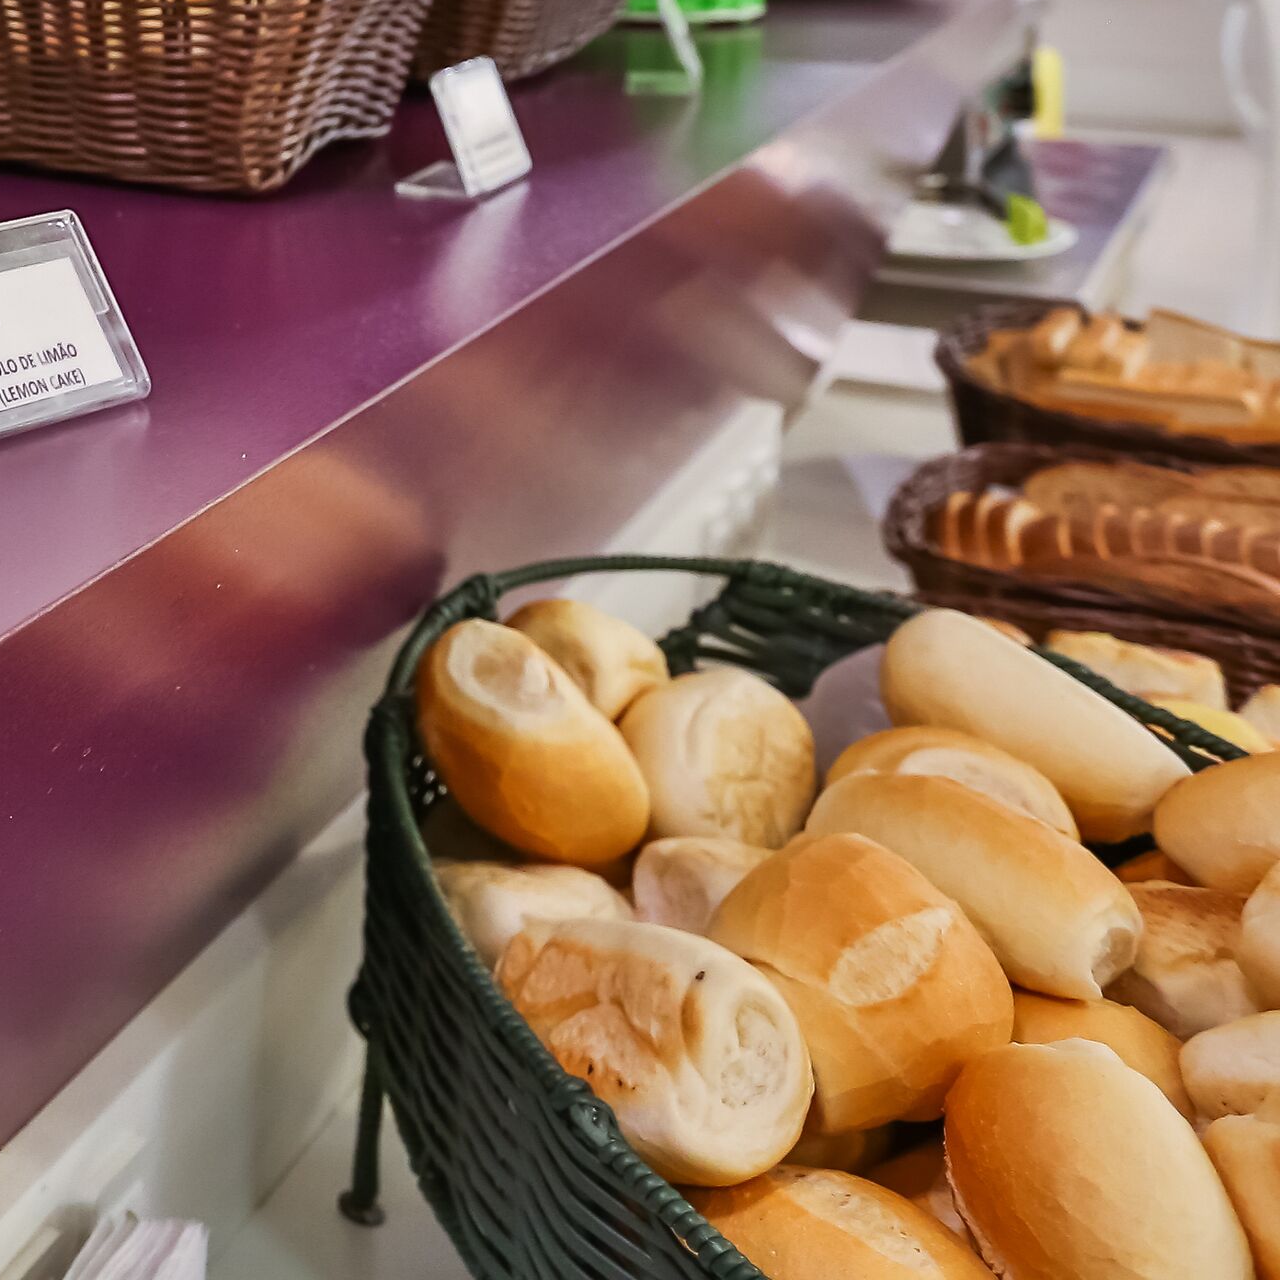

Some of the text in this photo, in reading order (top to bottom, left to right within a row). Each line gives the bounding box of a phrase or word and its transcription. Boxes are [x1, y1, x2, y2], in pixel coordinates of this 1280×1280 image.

[18, 354, 37, 371] DE
[37, 342, 78, 367] LIMÃO
[50, 367, 87, 391] CAKE)
